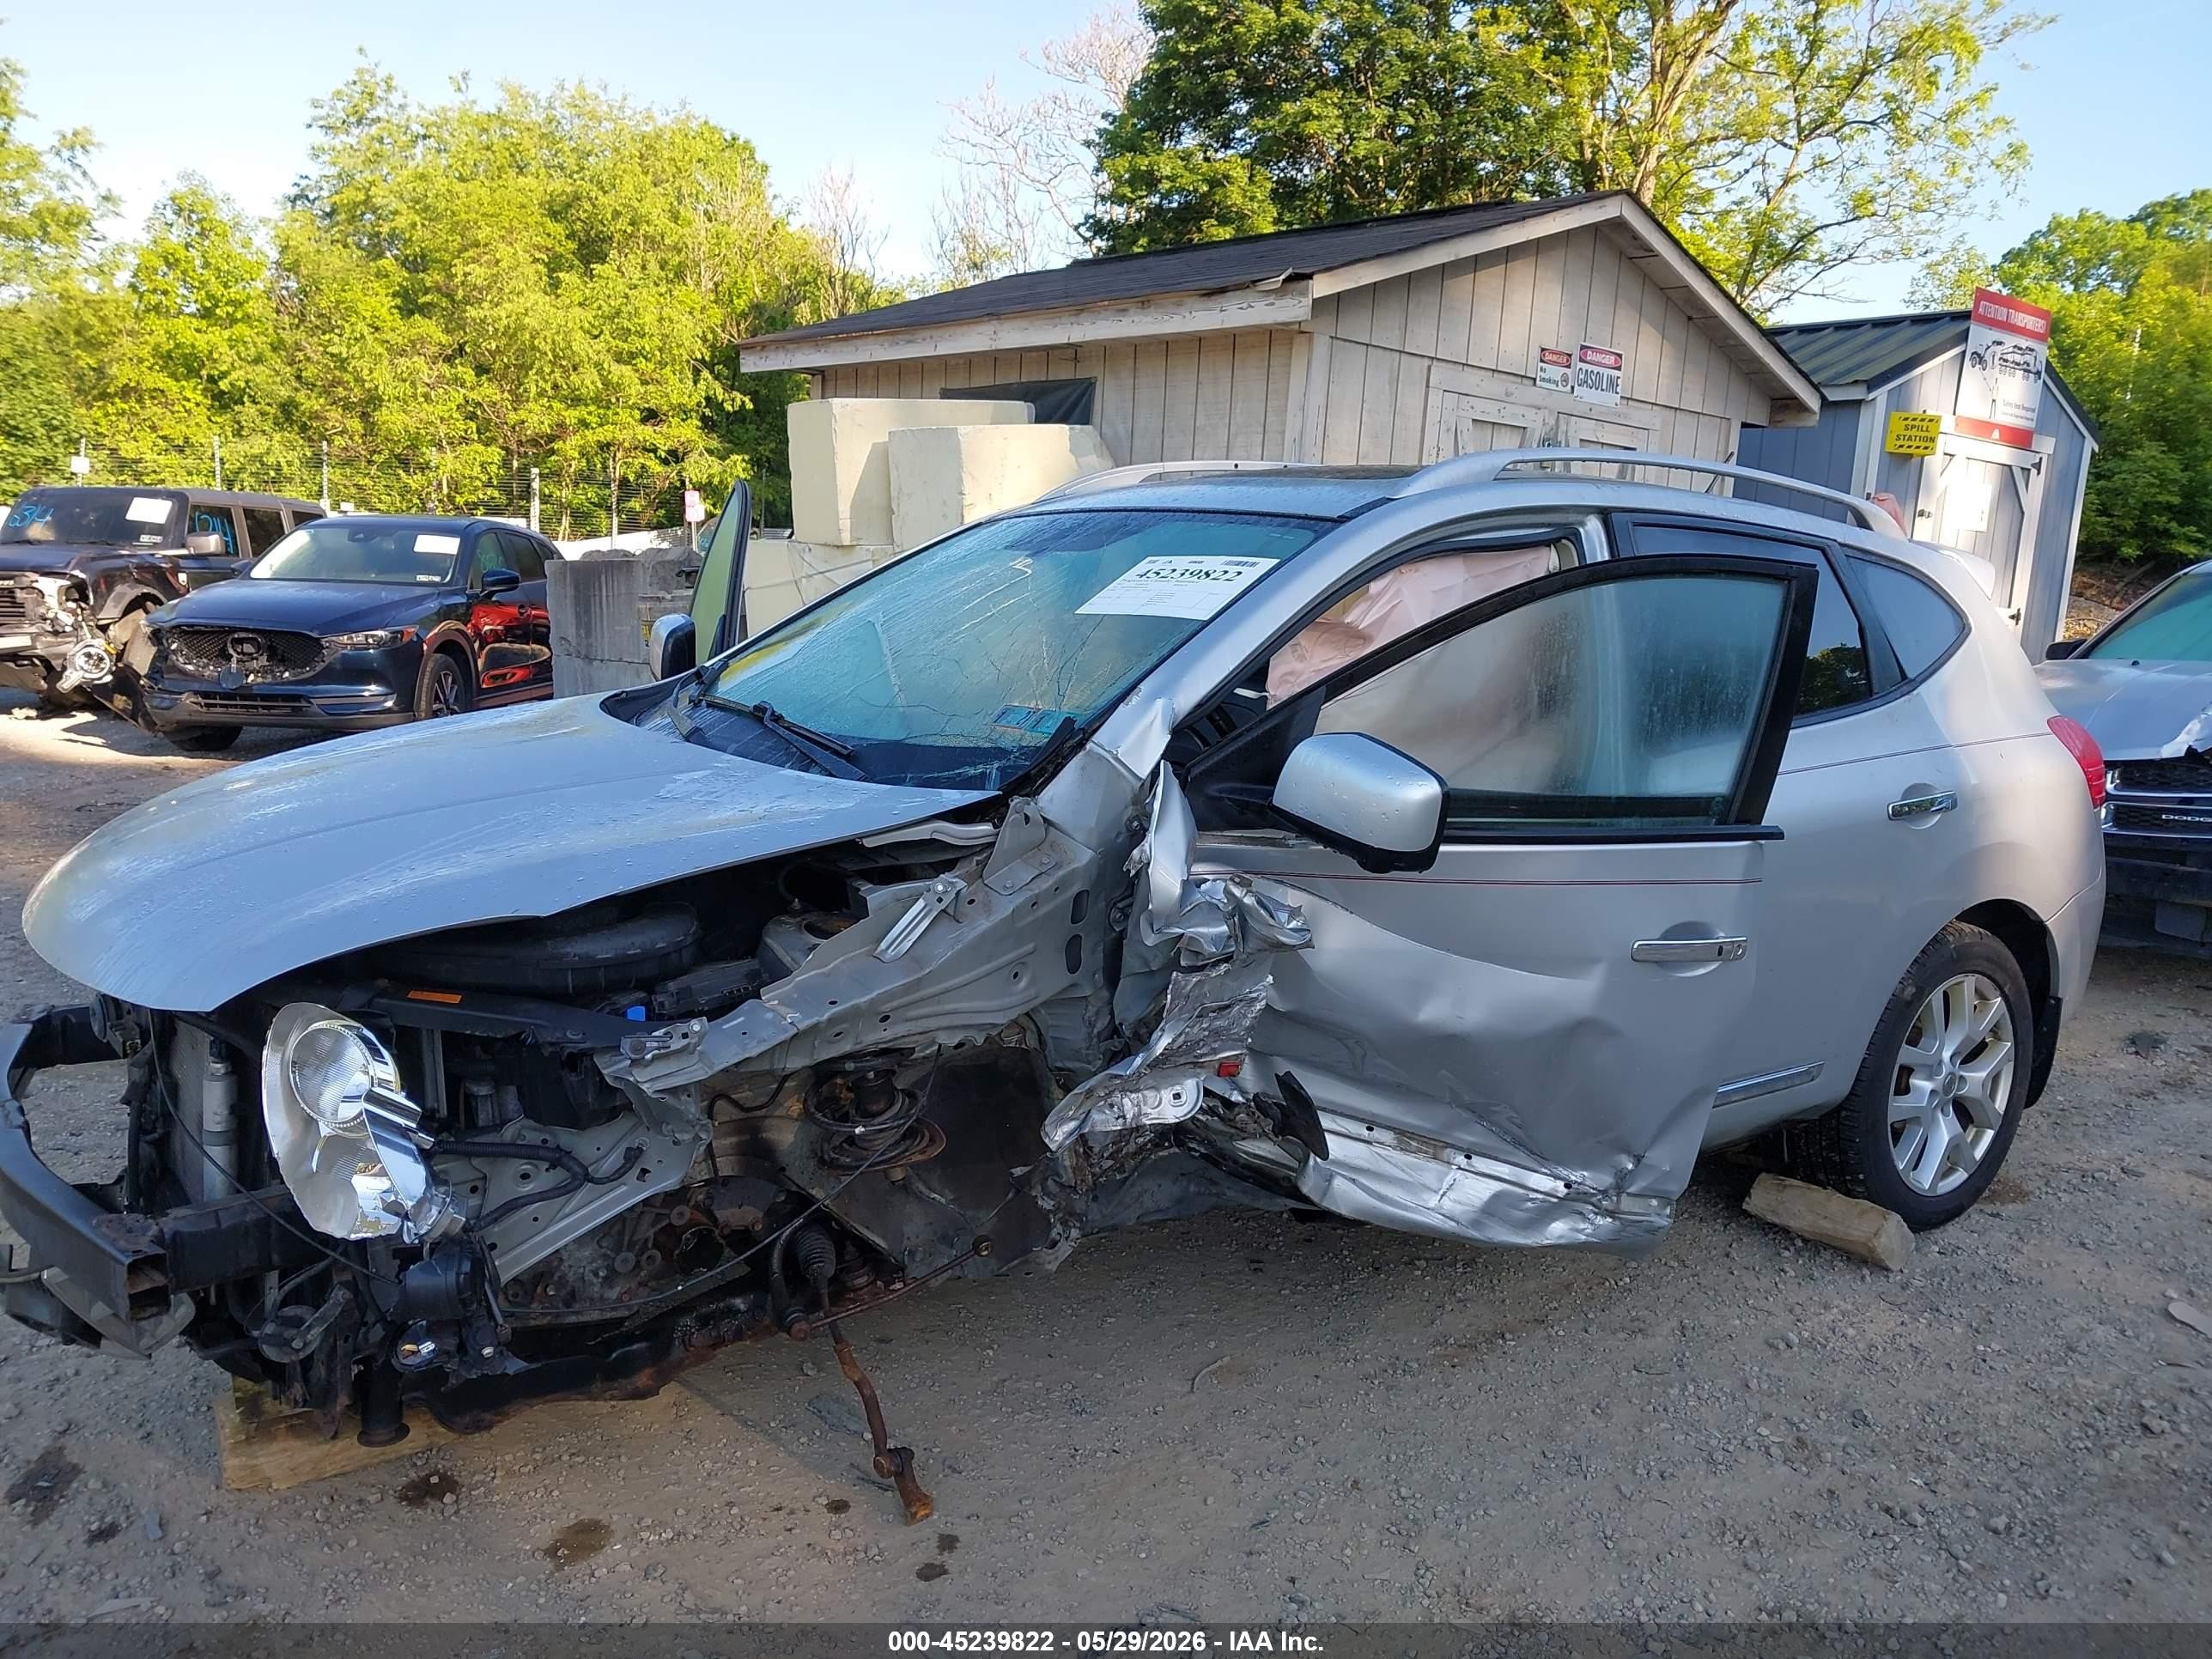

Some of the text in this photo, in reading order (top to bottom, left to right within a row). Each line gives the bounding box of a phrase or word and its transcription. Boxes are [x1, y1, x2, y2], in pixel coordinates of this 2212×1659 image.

[1545, 352, 1567, 364] DANGER
[1586, 350, 1615, 366] DANGER
[1539, 374, 1559, 387] Smoking
[1577, 368, 1621, 395] GASOLINE
[1903, 423, 1931, 433] SPILL
[1895, 434, 1936, 443] STATION
[1134, 568, 1243, 583] 45239822
